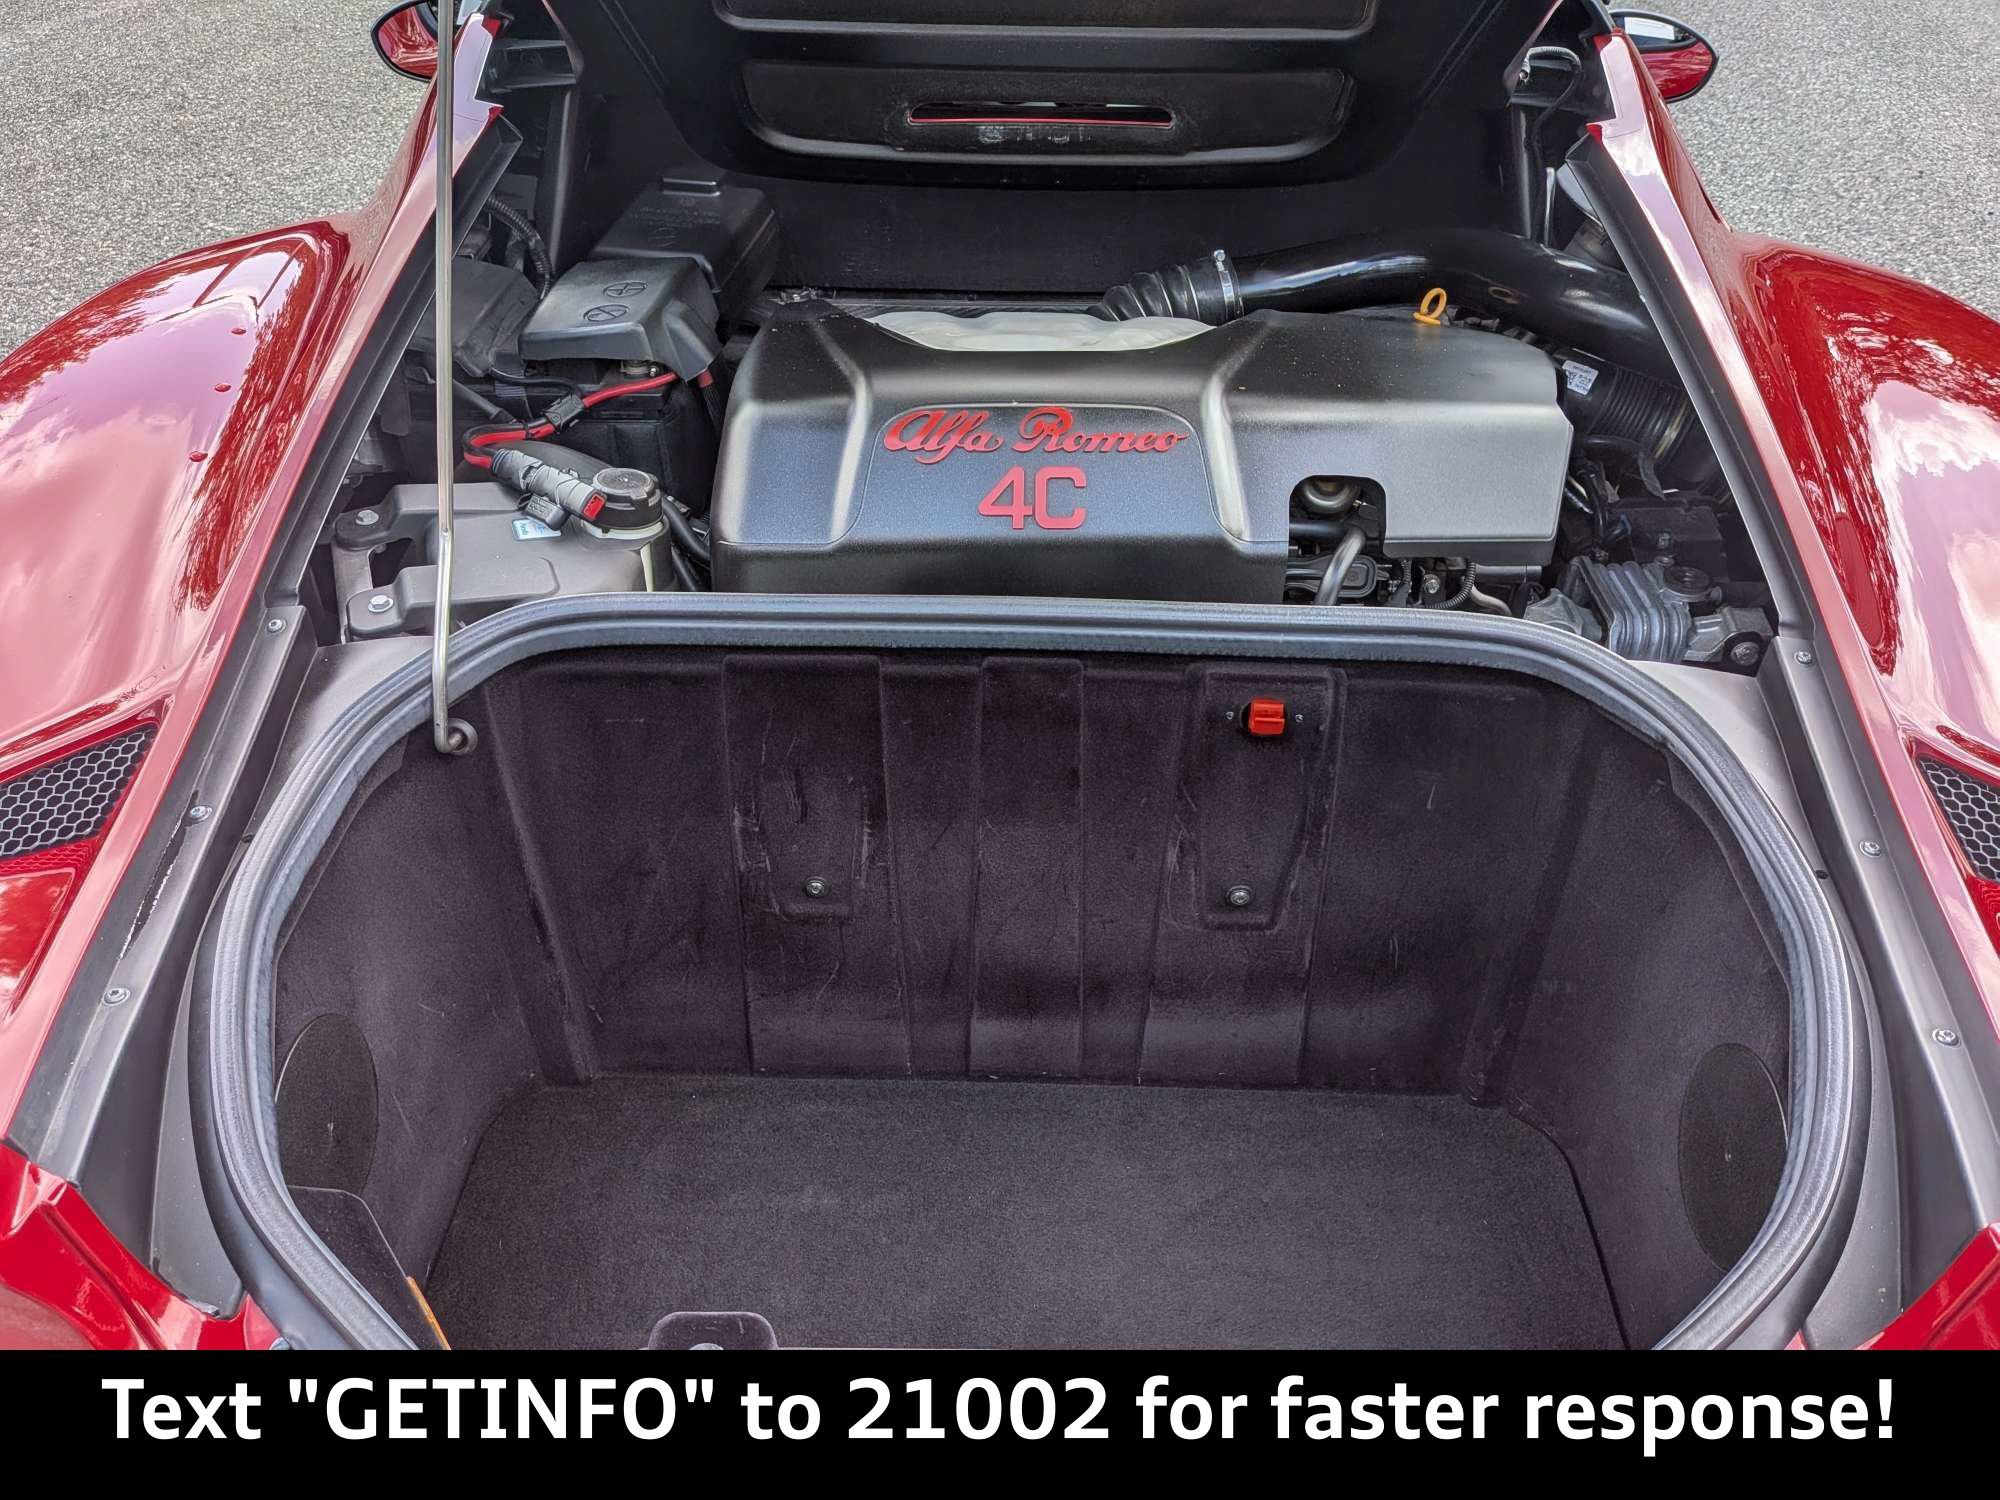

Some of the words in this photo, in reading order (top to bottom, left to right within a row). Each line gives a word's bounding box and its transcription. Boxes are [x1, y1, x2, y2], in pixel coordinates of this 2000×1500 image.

[884, 410, 1003, 465] Alfa
[1011, 406, 1188, 453] Romeo
[978, 466, 1088, 530] 4C
